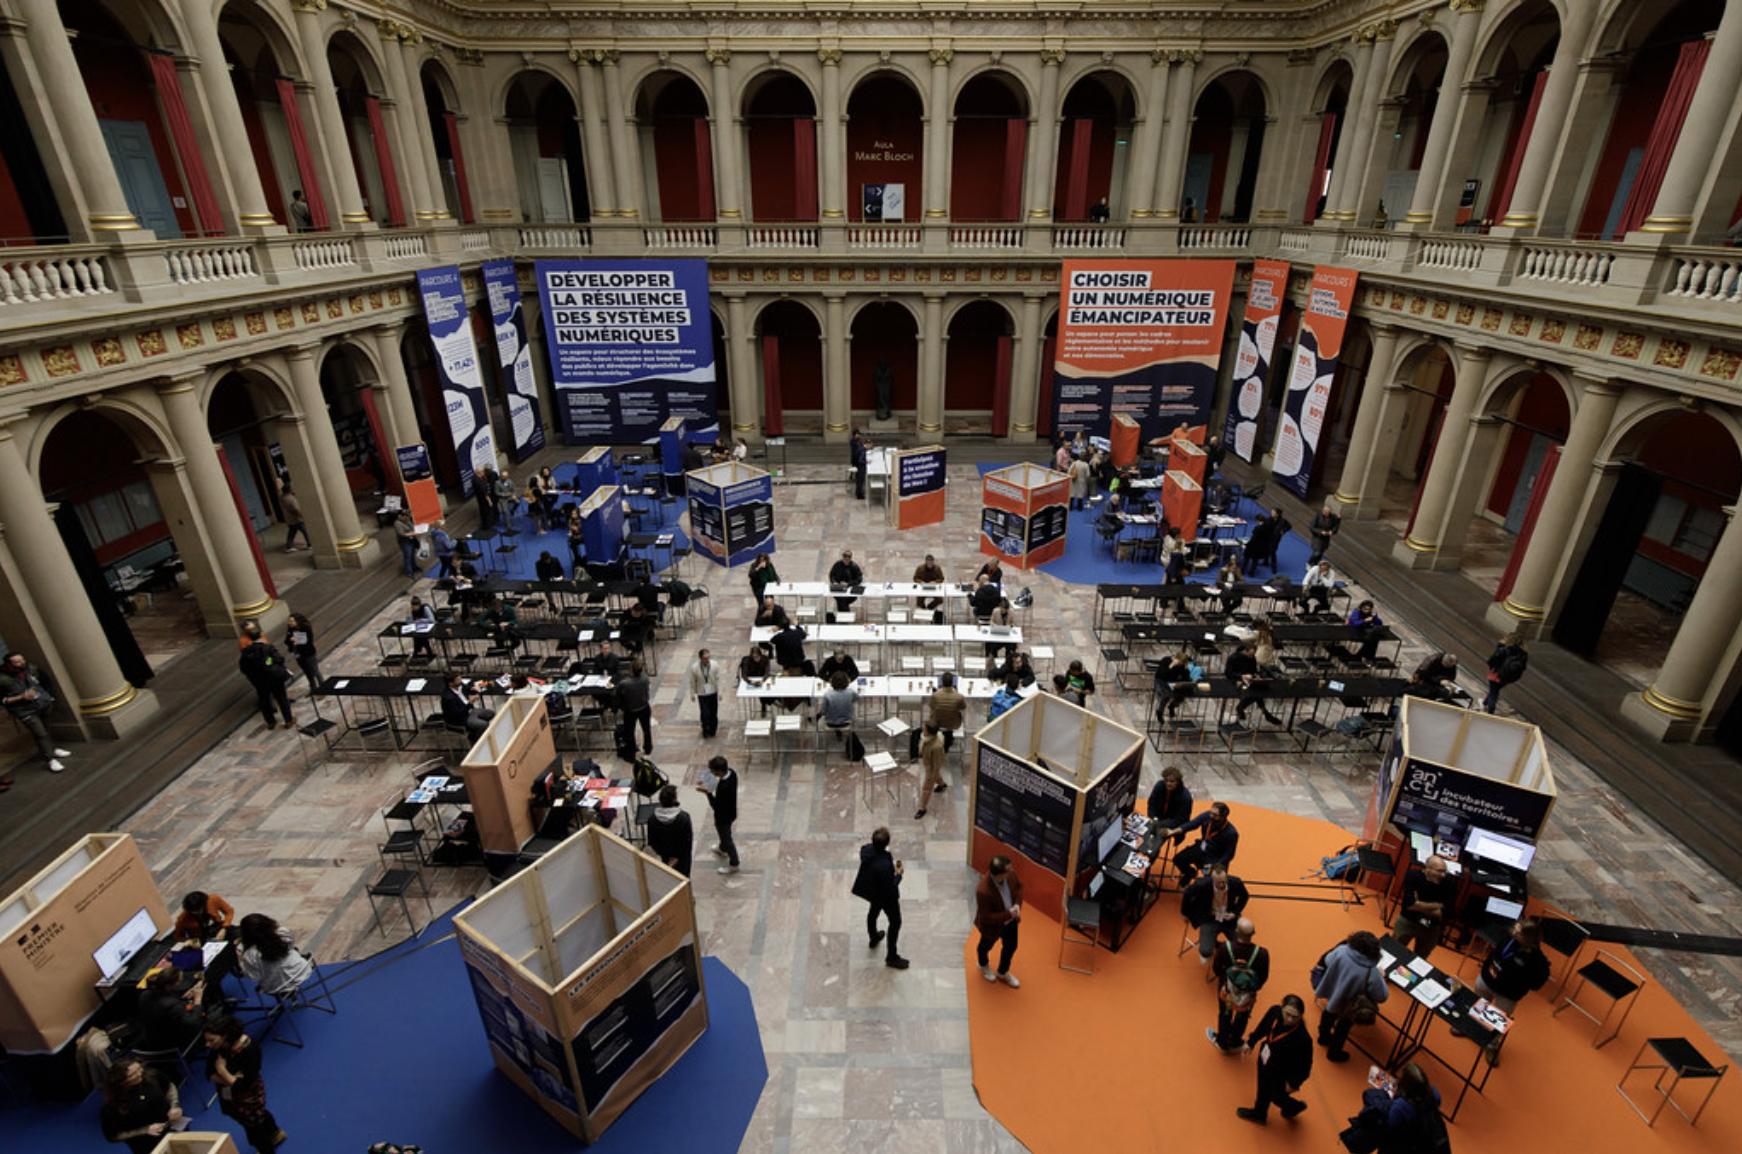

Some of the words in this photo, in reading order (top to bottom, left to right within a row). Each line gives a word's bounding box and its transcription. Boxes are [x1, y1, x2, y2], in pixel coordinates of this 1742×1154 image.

[420, 274, 453, 286] PARCOURS
[550, 270, 670, 287] DÉVELOPPER
[1074, 274, 1148, 287] CHOISIR
[1314, 273, 1348, 286] PARCOURS
[553, 293, 578, 306] LA
[582, 290, 683, 306] RÉSILIENCE
[1073, 293, 1097, 305] UN
[1103, 289, 1211, 308] NUMÉRIQUE
[556, 312, 592, 324] DES
[596, 308, 686, 324] SYSTÈMES
[1070, 307, 1211, 324] ÉMANCIPATEUR
[558, 326, 676, 344] NUMÉRIQUES
[1442, 788, 1505, 811] incubateur
[1440, 797, 1459, 807] des
[1462, 802, 1519, 824] territoires
[23, 922, 57, 954] PREMIER
[26, 924, 65, 960] MINISTRE
